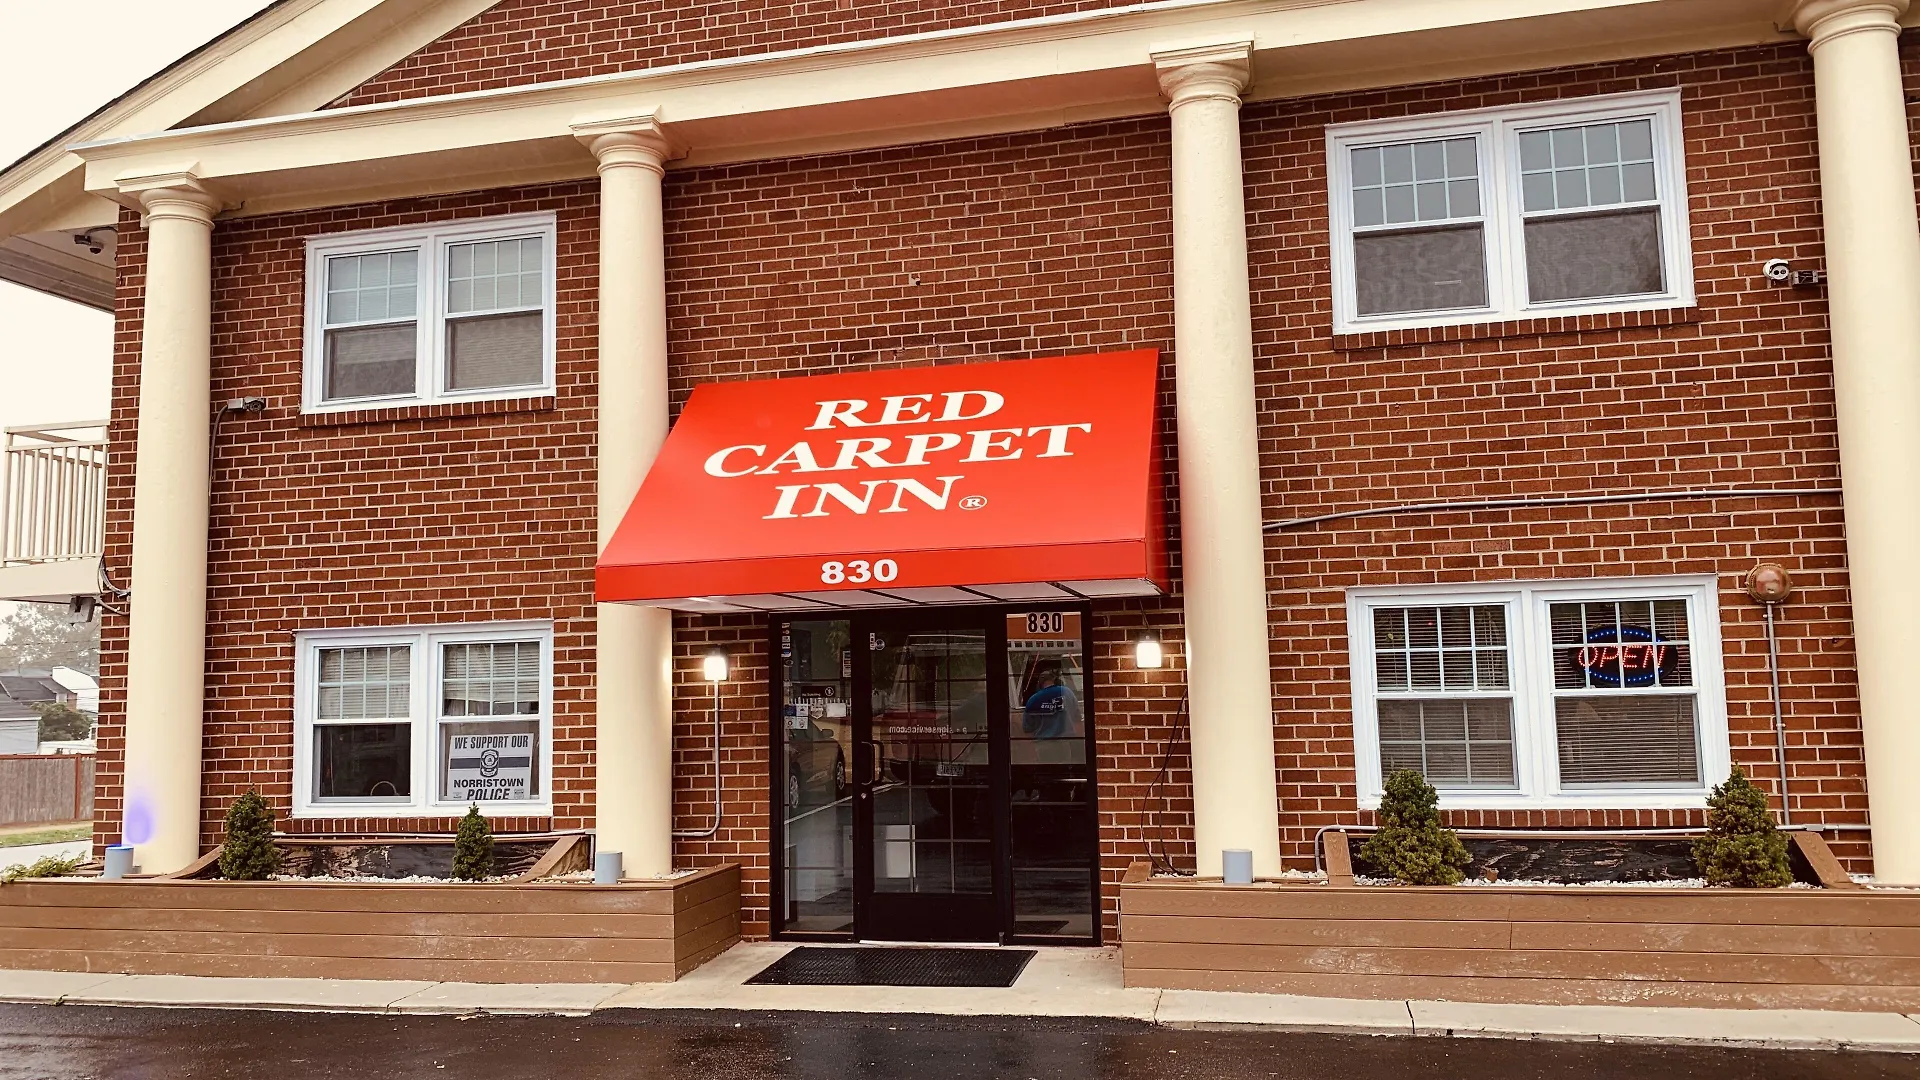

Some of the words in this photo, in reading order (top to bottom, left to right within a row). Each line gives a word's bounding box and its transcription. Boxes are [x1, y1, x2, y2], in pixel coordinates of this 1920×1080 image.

[804, 390, 1004, 431] RED
[704, 423, 1092, 478] CARPET
[762, 475, 964, 520] INN
[820, 558, 899, 585] 830
[1027, 612, 1063, 633] 830
[1578, 643, 1666, 669] OPEN
[454, 736, 468, 750] WE
[470, 735, 509, 749] SUPPORT
[511, 735, 529, 748] OUR
[453, 778, 524, 788] NORRISTOWN
[466, 788, 511, 801] POLICE
